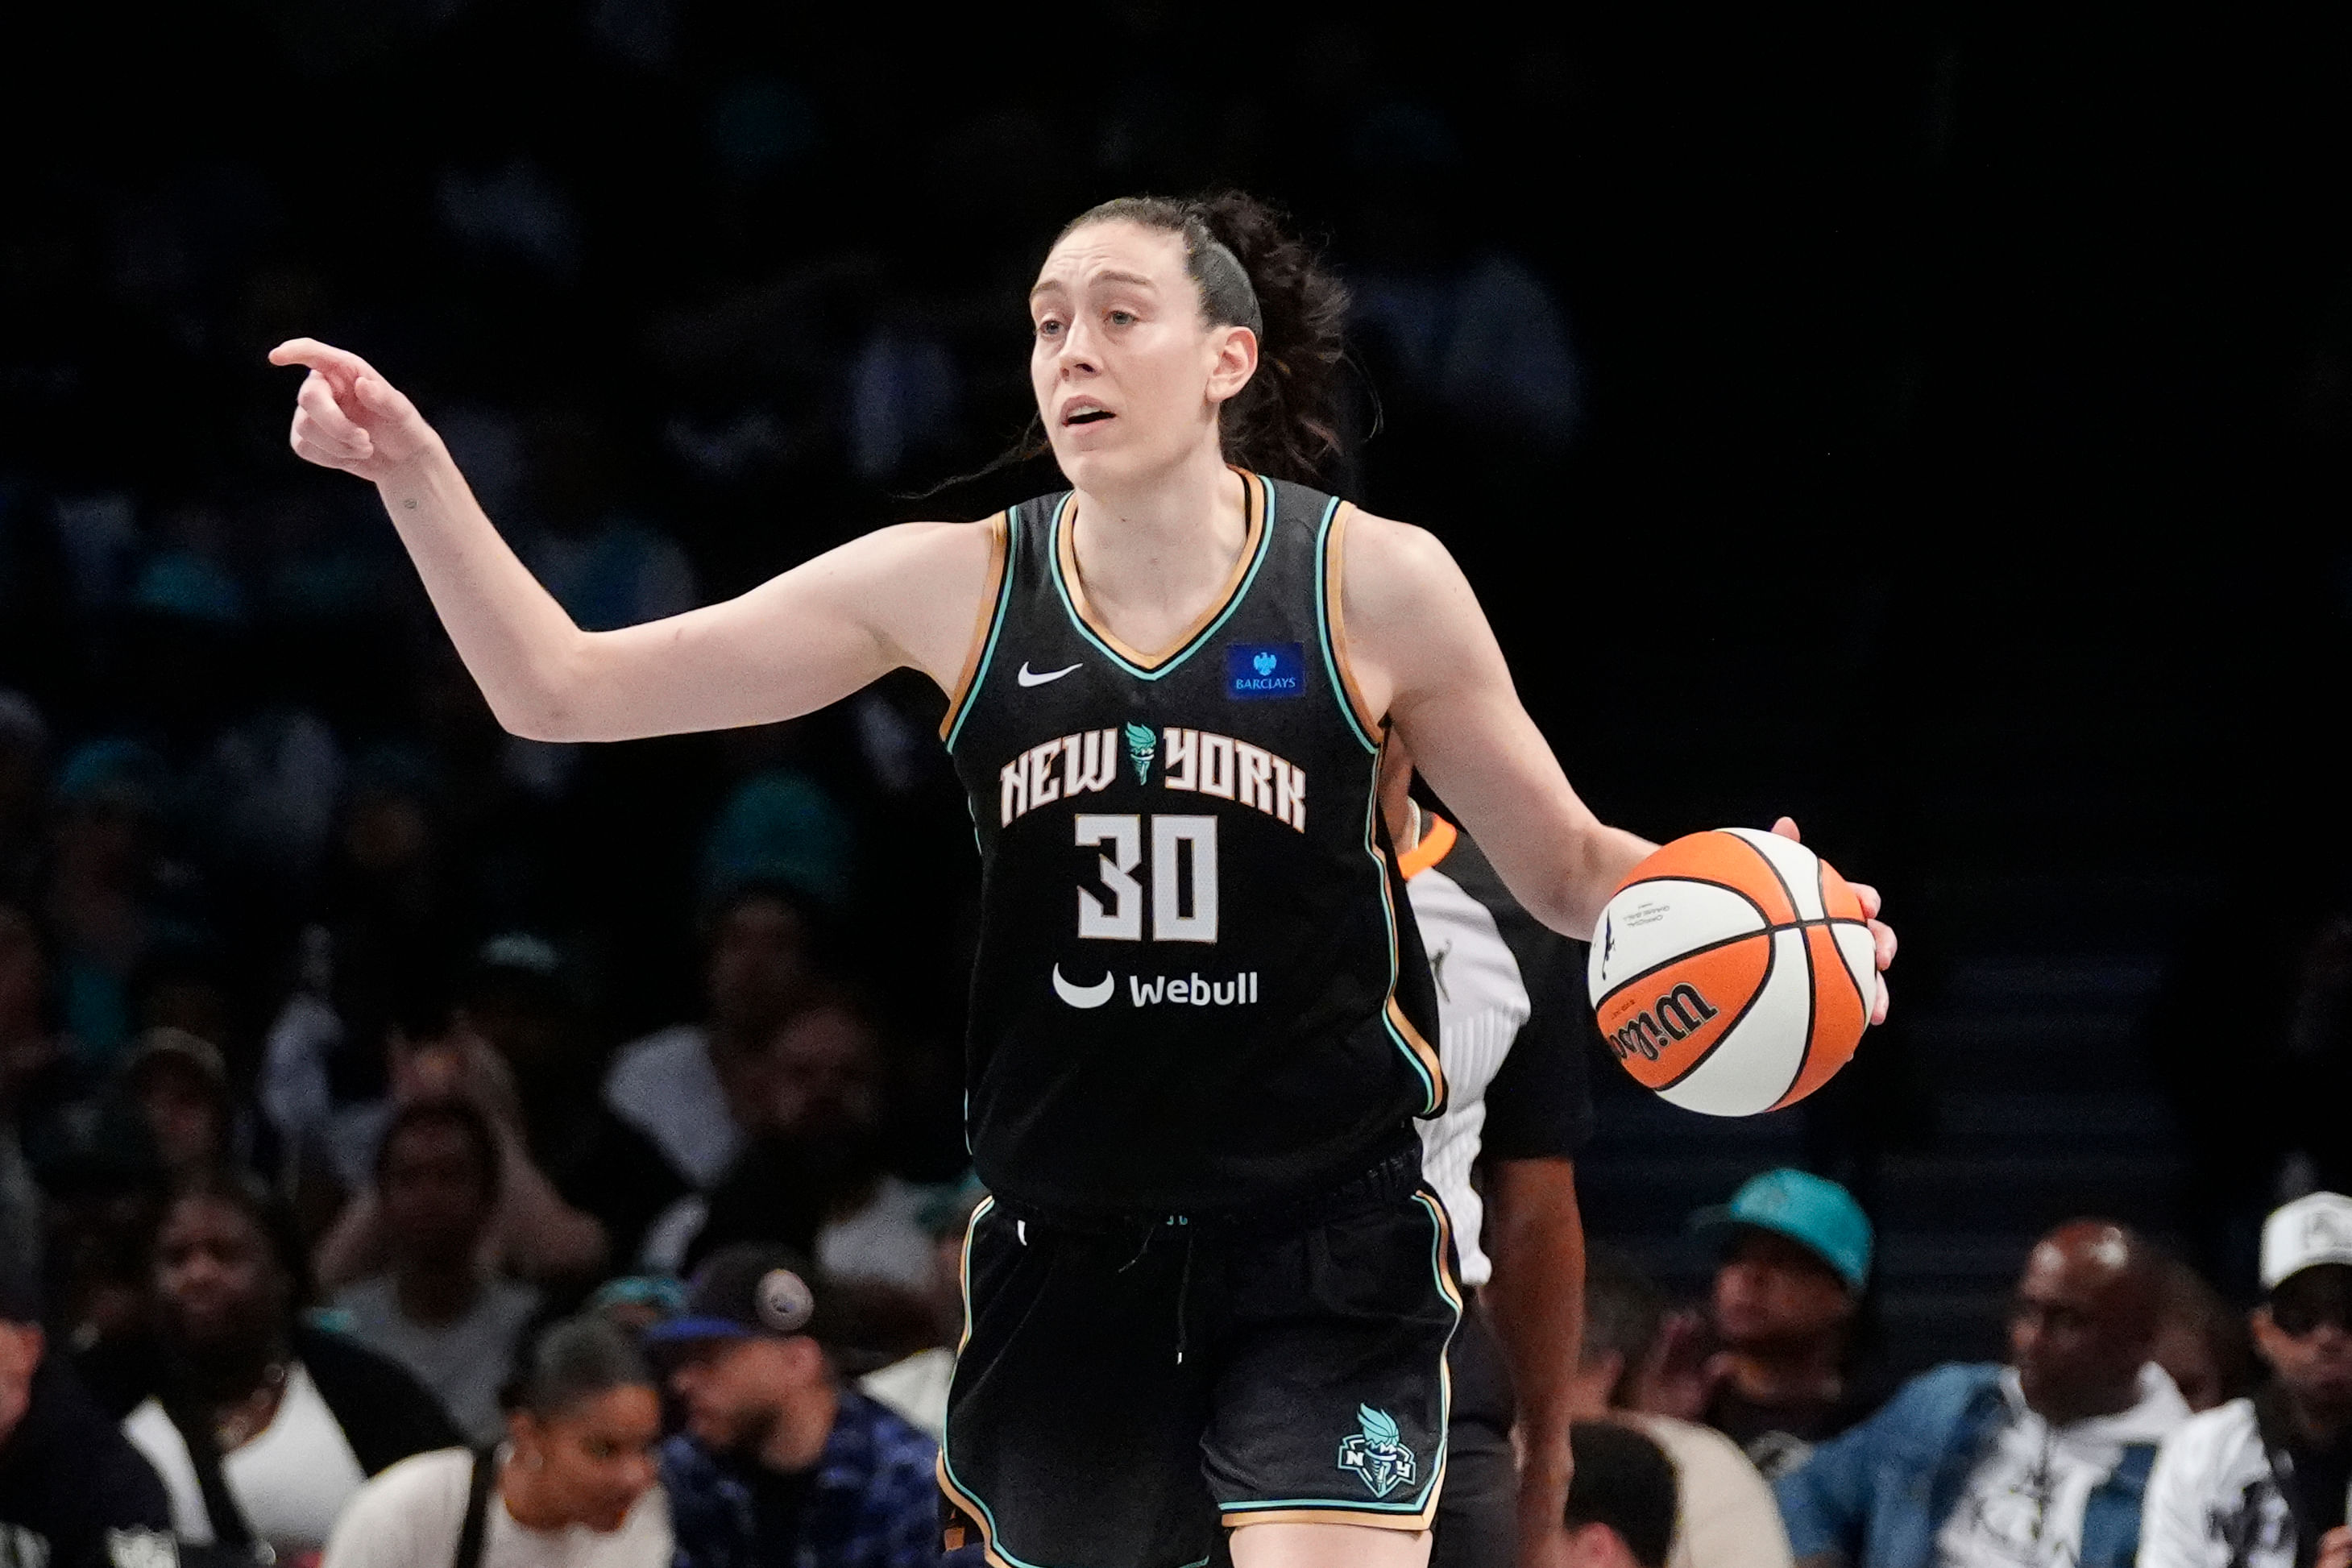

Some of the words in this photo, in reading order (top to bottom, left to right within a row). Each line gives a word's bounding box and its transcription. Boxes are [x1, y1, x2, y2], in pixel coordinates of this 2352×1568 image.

[1236, 677, 1296, 691] BARCLAYS
[1000, 727, 1119, 829] NEW
[1163, 727, 1306, 835] YORK
[1074, 813, 1219, 944] 30
[1129, 972, 1259, 1007] Webull
[1609, 981, 1719, 1061] Wilso
